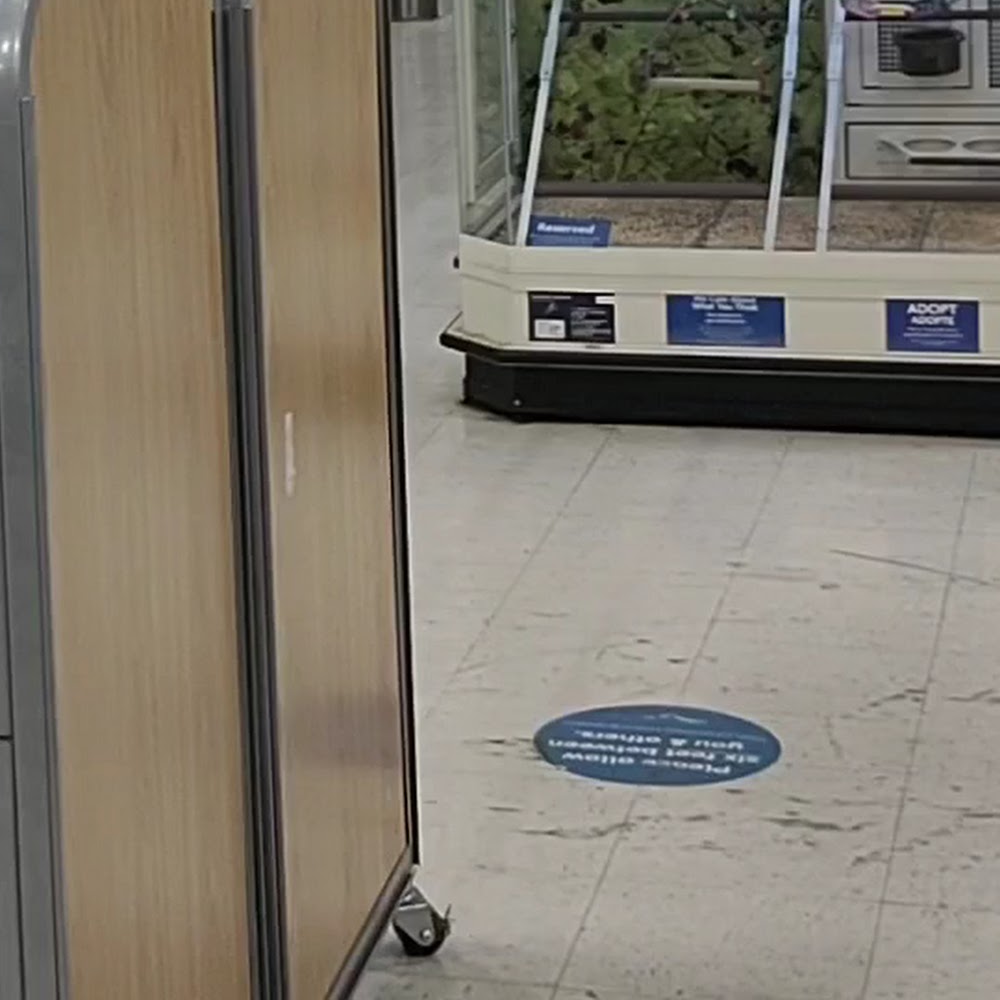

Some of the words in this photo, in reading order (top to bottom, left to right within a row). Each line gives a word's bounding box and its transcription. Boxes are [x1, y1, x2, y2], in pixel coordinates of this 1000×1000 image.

[537, 222, 596, 235] Reserved
[906, 303, 957, 315] ADOPT
[548, 739, 658, 757] between
[670, 738, 687, 748] &
[694, 739, 744, 750] you
[562, 752, 635, 766] allow
[665, 748, 716, 761] feet
[725, 752, 761, 764] six
[642, 758, 732, 775] Please
